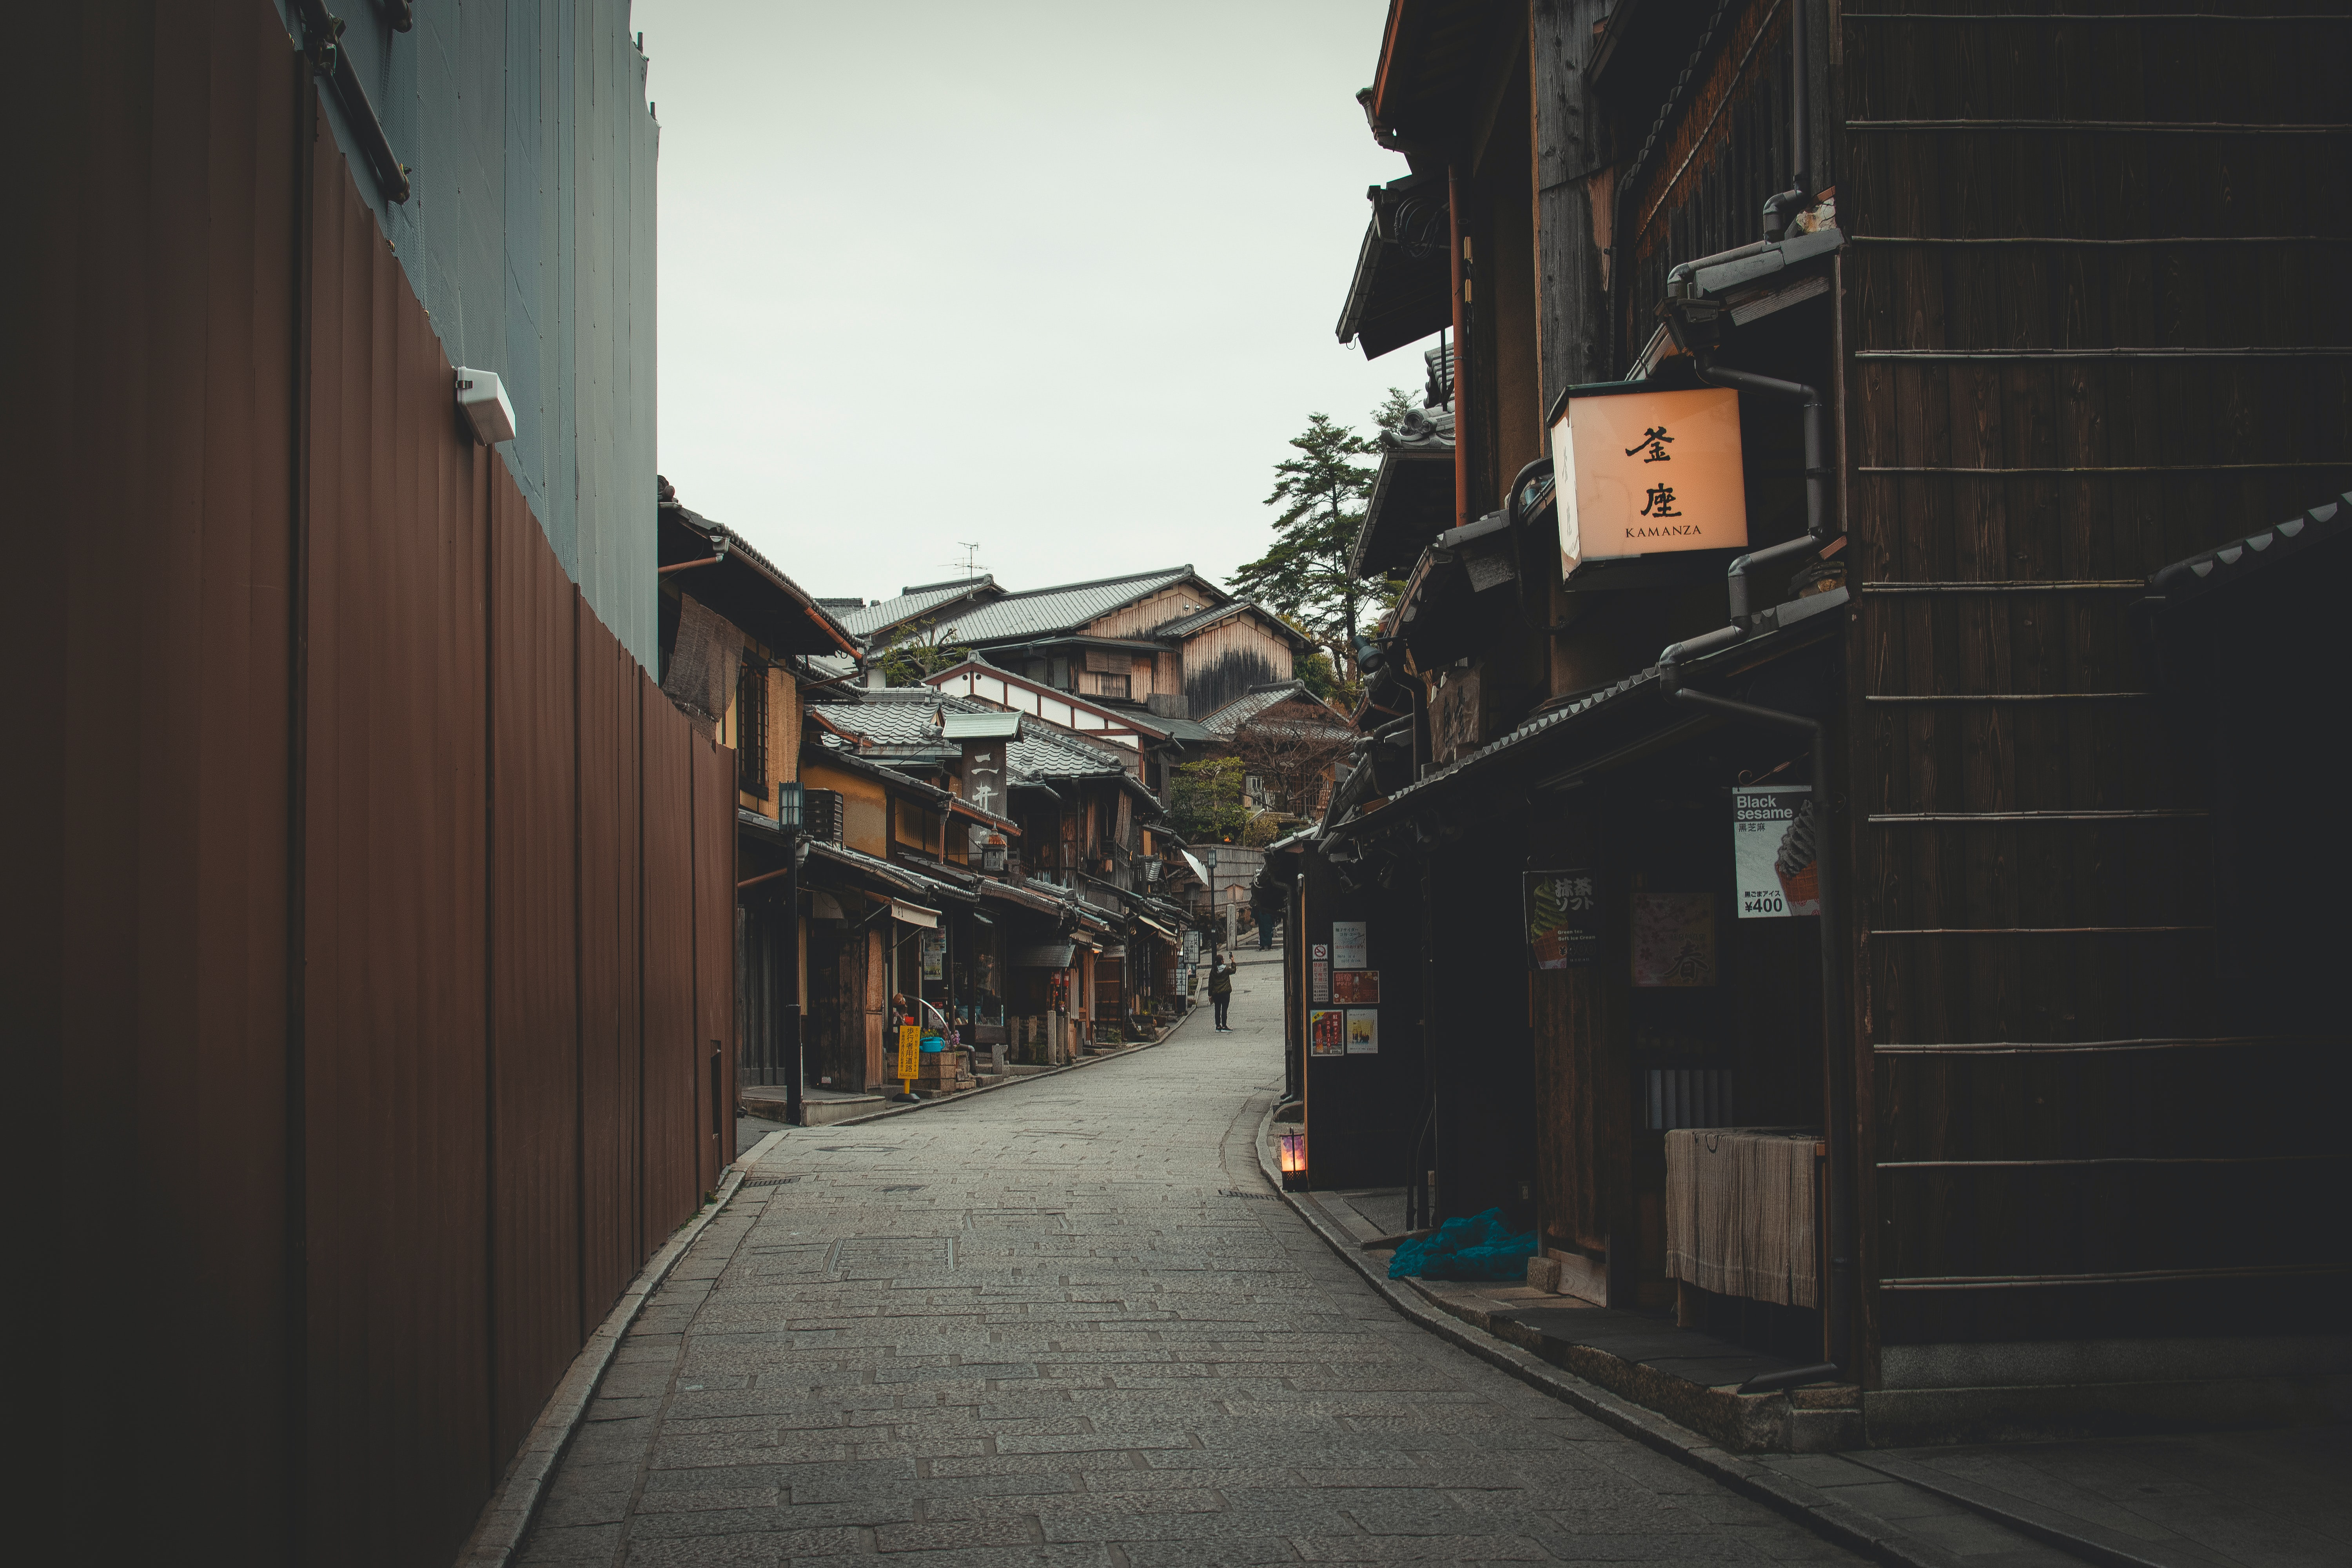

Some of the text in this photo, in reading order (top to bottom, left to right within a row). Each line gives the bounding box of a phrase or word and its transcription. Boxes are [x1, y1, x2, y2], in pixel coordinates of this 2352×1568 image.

[1625, 426, 1682, 518] 釜座
[1626, 525, 1701, 537] KAMANZA
[1737, 795, 1776, 808] Black
[1737, 808, 1793, 820] sesame
[1555, 877, 1592, 898] 抹茶
[1555, 897, 1594, 911] ソフト
[1745, 898, 1782, 912] ¥400
[1558, 942, 1596, 956] ¥400
[1662, 939, 1709, 980] 春
[906, 1027, 914, 1072] 歩行者用道路
